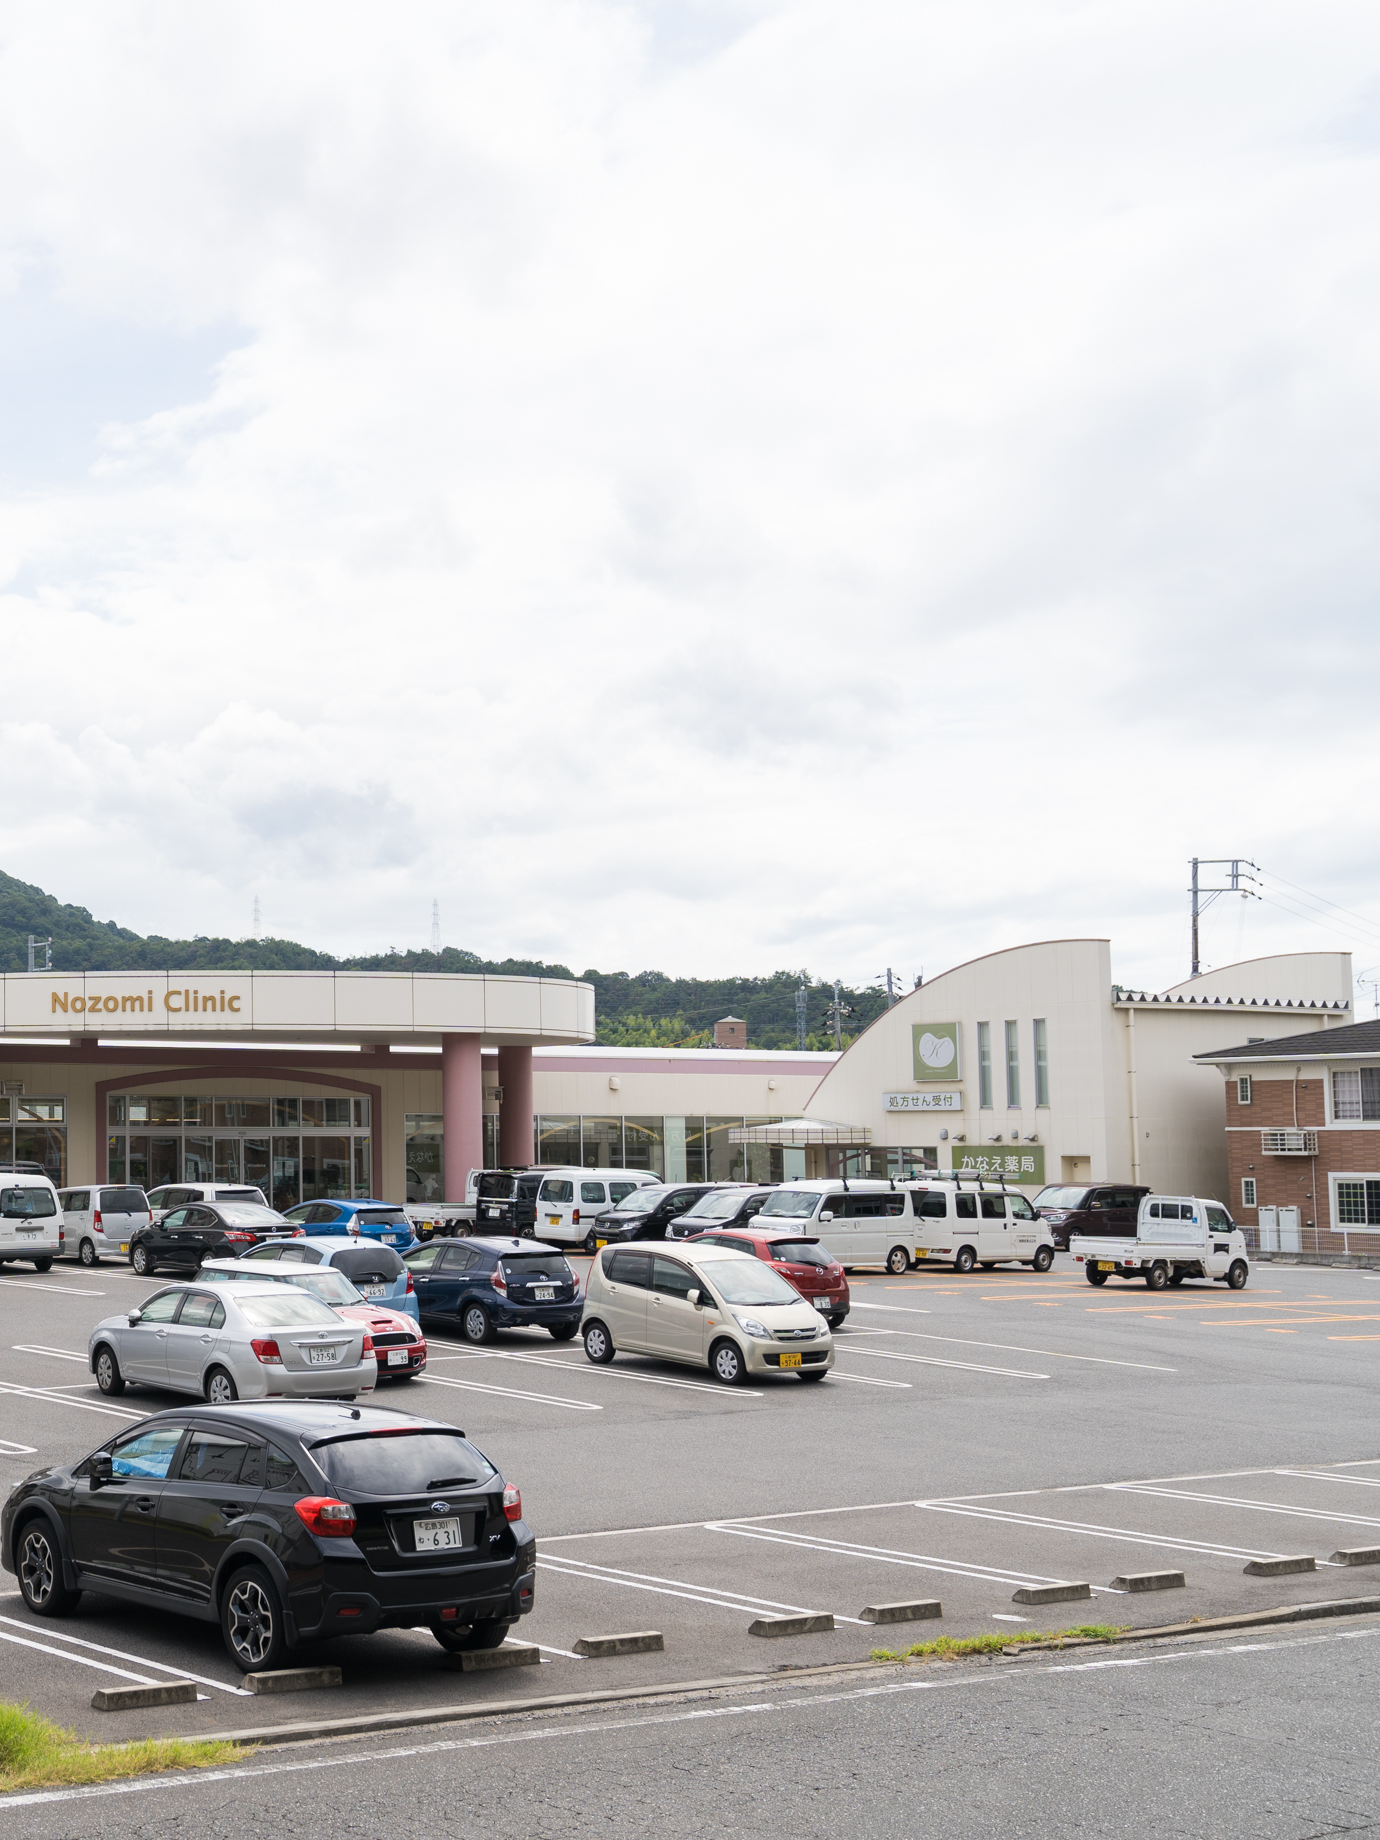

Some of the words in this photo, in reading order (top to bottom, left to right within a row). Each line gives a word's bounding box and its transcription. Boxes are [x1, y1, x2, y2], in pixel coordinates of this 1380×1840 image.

[51, 990, 153, 1013] Nozomi
[164, 989, 241, 1012] Clinic
[889, 1094, 953, 1107] 処方せん受付
[961, 1155, 1035, 1172] かなえ薬局
